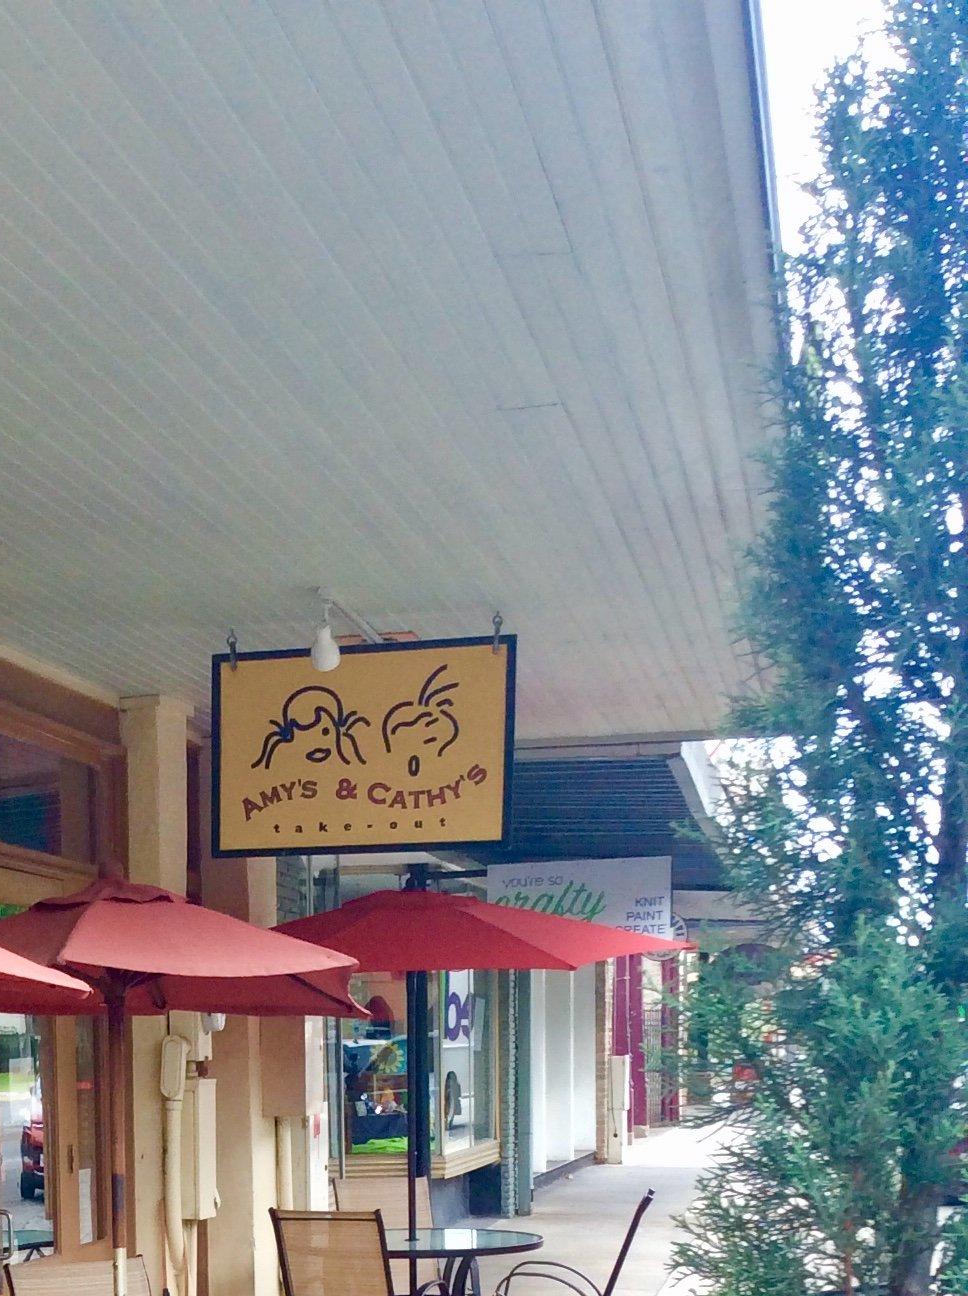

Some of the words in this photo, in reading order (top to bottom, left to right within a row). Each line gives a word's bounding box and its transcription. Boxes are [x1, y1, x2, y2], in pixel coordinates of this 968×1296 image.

[241, 778, 318, 822] AMY'S
[335, 777, 358, 801] &
[367, 763, 488, 811] CATHY'S
[273, 818, 447, 835] take-out
[548, 874, 564, 886] so
[634, 896, 665, 908] KNIT
[626, 910, 664, 922] PAINT
